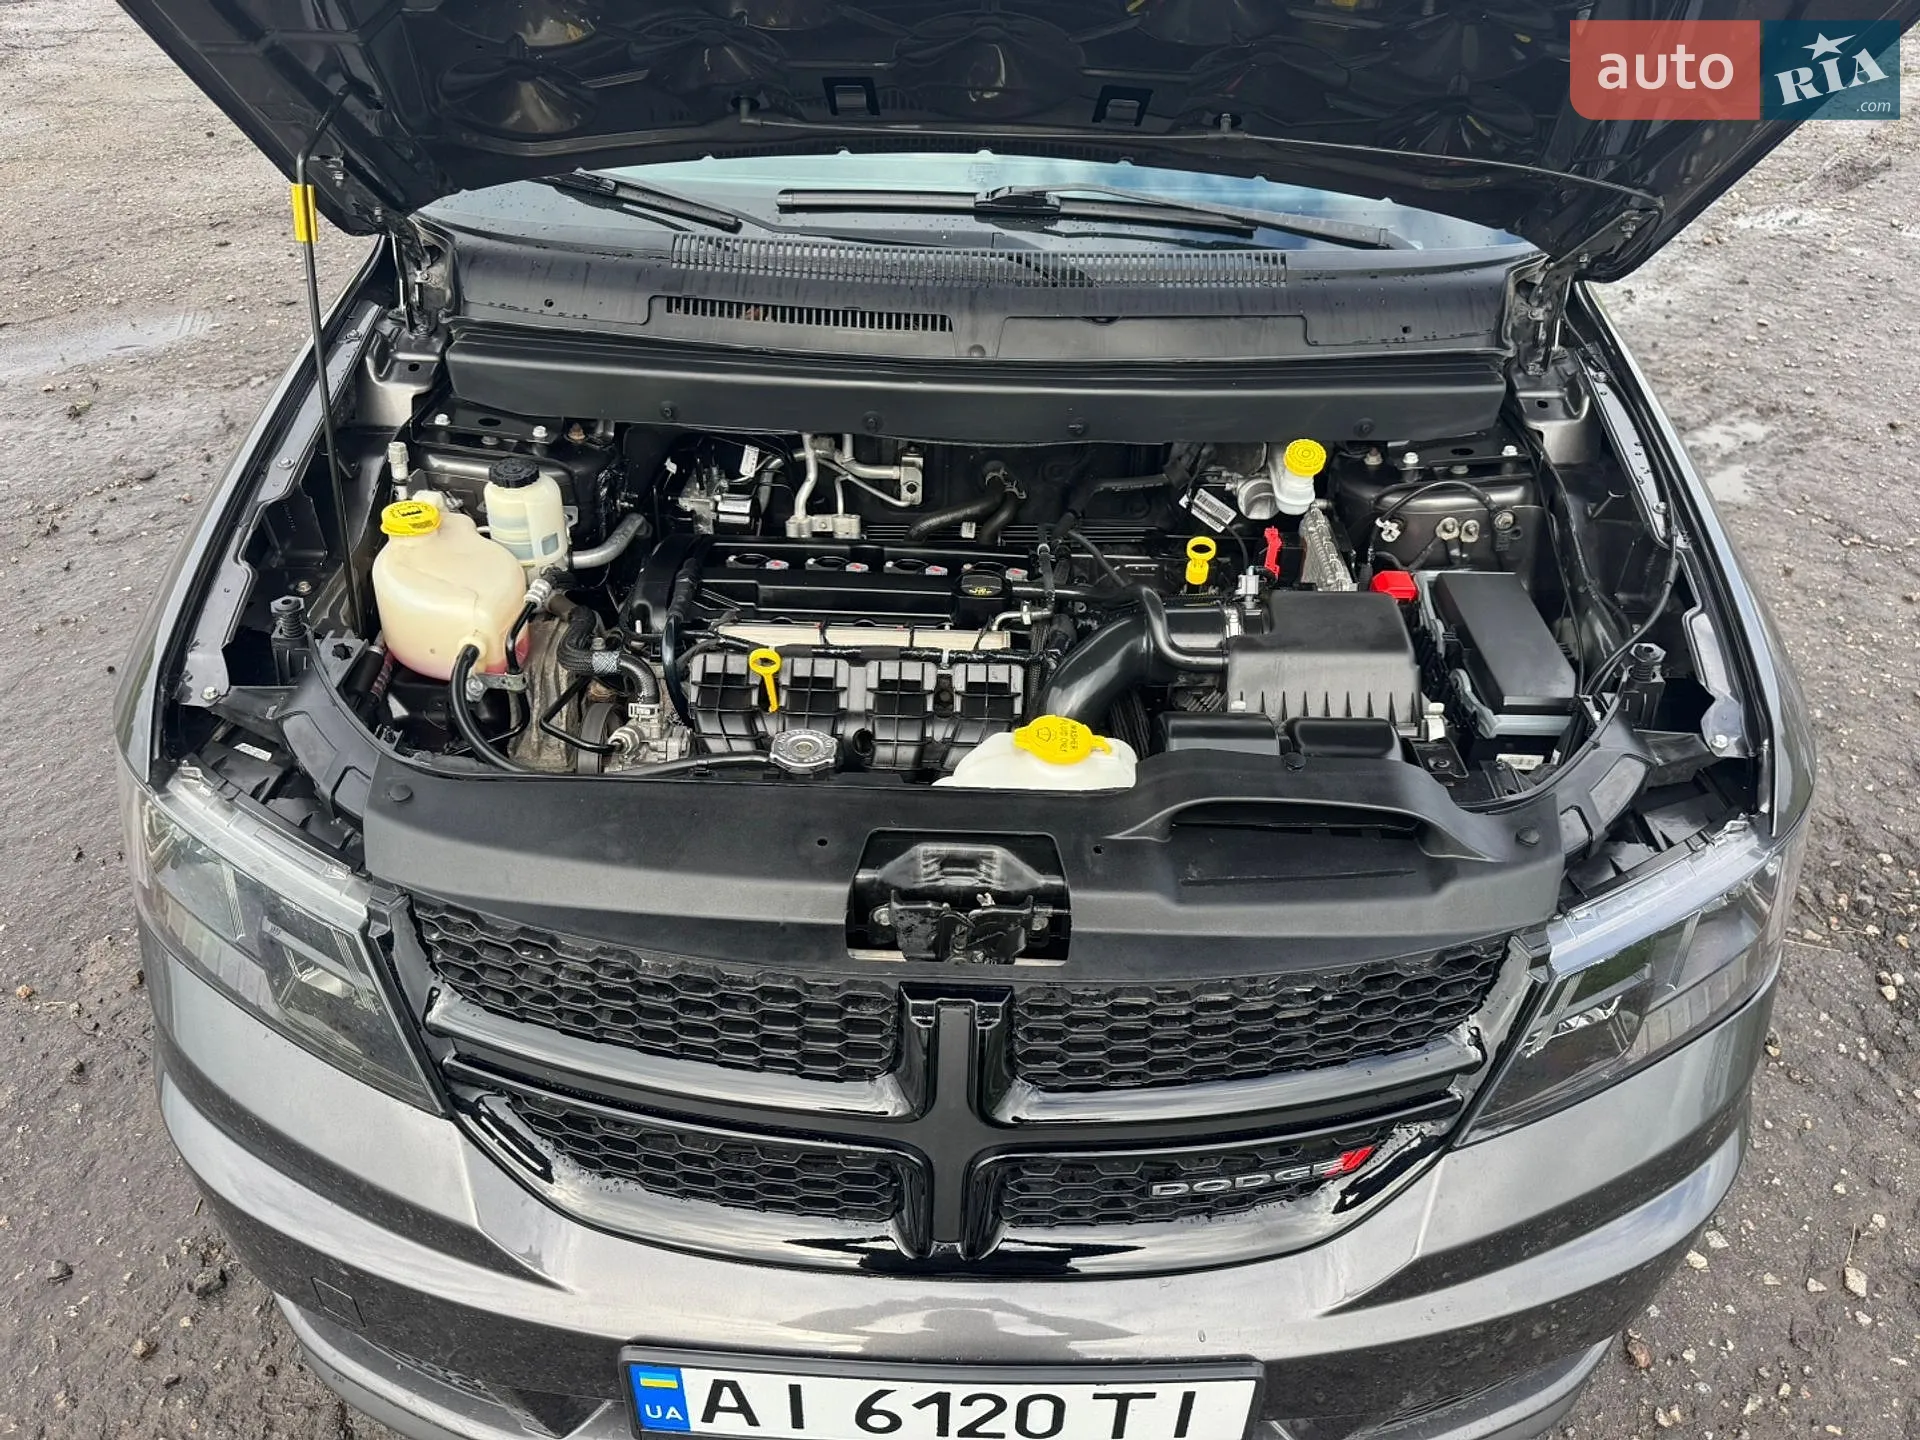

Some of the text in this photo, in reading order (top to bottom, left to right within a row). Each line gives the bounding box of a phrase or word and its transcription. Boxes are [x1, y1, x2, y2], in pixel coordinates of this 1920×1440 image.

[1152, 1157, 1344, 1196] DODGE
[645, 1404, 684, 1421] UA
[701, 1378, 1196, 1439] AI 6120 TI
